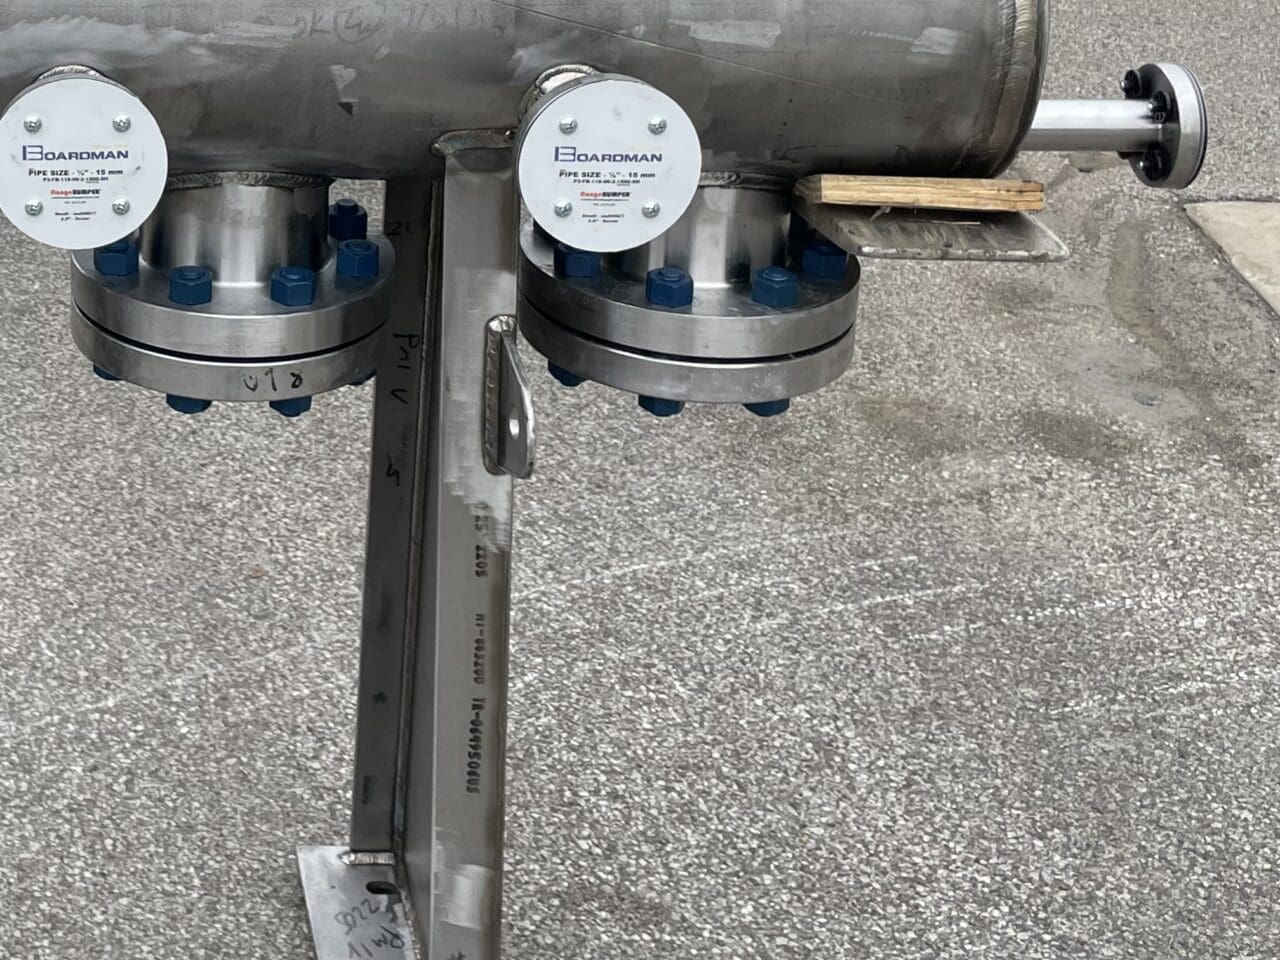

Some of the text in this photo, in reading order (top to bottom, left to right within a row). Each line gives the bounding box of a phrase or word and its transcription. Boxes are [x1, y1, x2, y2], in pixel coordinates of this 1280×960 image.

[22, 144, 129, 161] BOARDMAN
[554, 146, 663, 163] BOARDMAN
[28, 168, 48, 176] PIPE
[559, 169, 579, 178] PIPE
